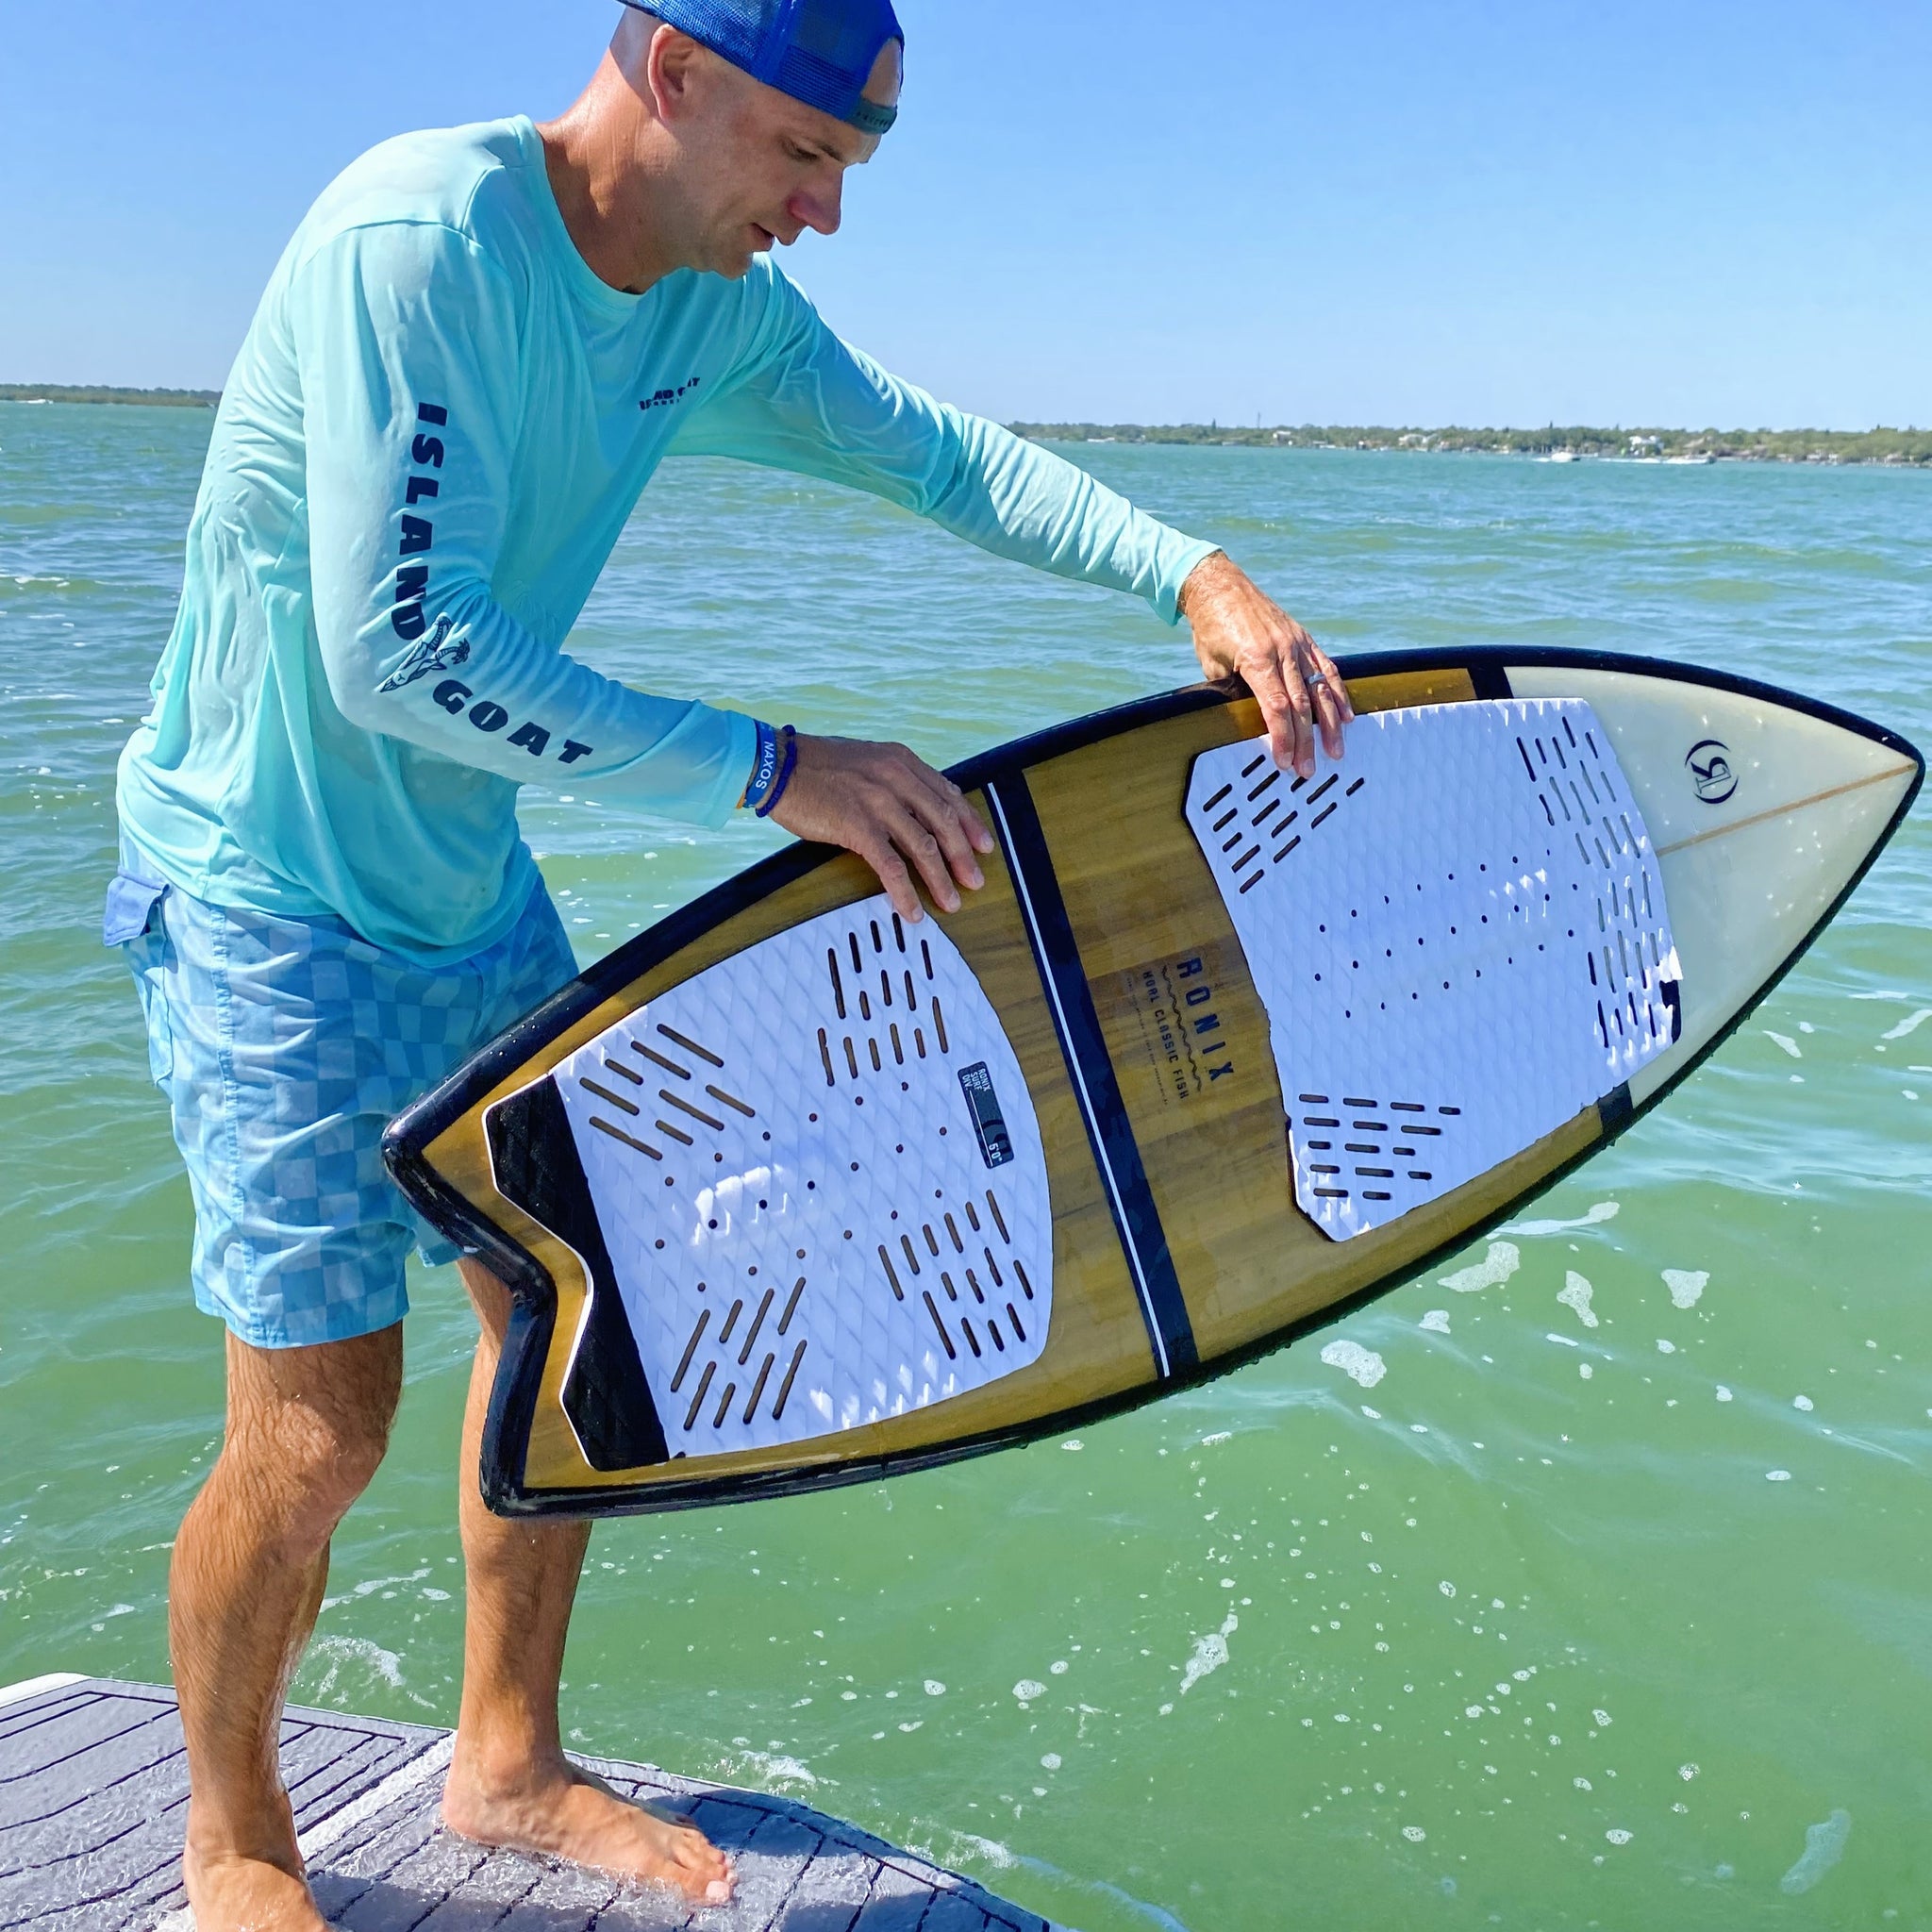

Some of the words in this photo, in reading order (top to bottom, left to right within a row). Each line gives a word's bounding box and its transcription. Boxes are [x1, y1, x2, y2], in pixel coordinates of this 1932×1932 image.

[391, 402, 448, 641] ISLAND
[433, 679, 593, 764] GOAT
[756, 741, 774, 790] NAXOS
[1155, 1008, 1179, 1064] CLASSIC
[1173, 1069, 1190, 1099] FISH
[1176, 957, 1235, 1082] RONIX
[971, 1072, 983, 1091] SURF
[978, 1068, 991, 1091] RONIX
